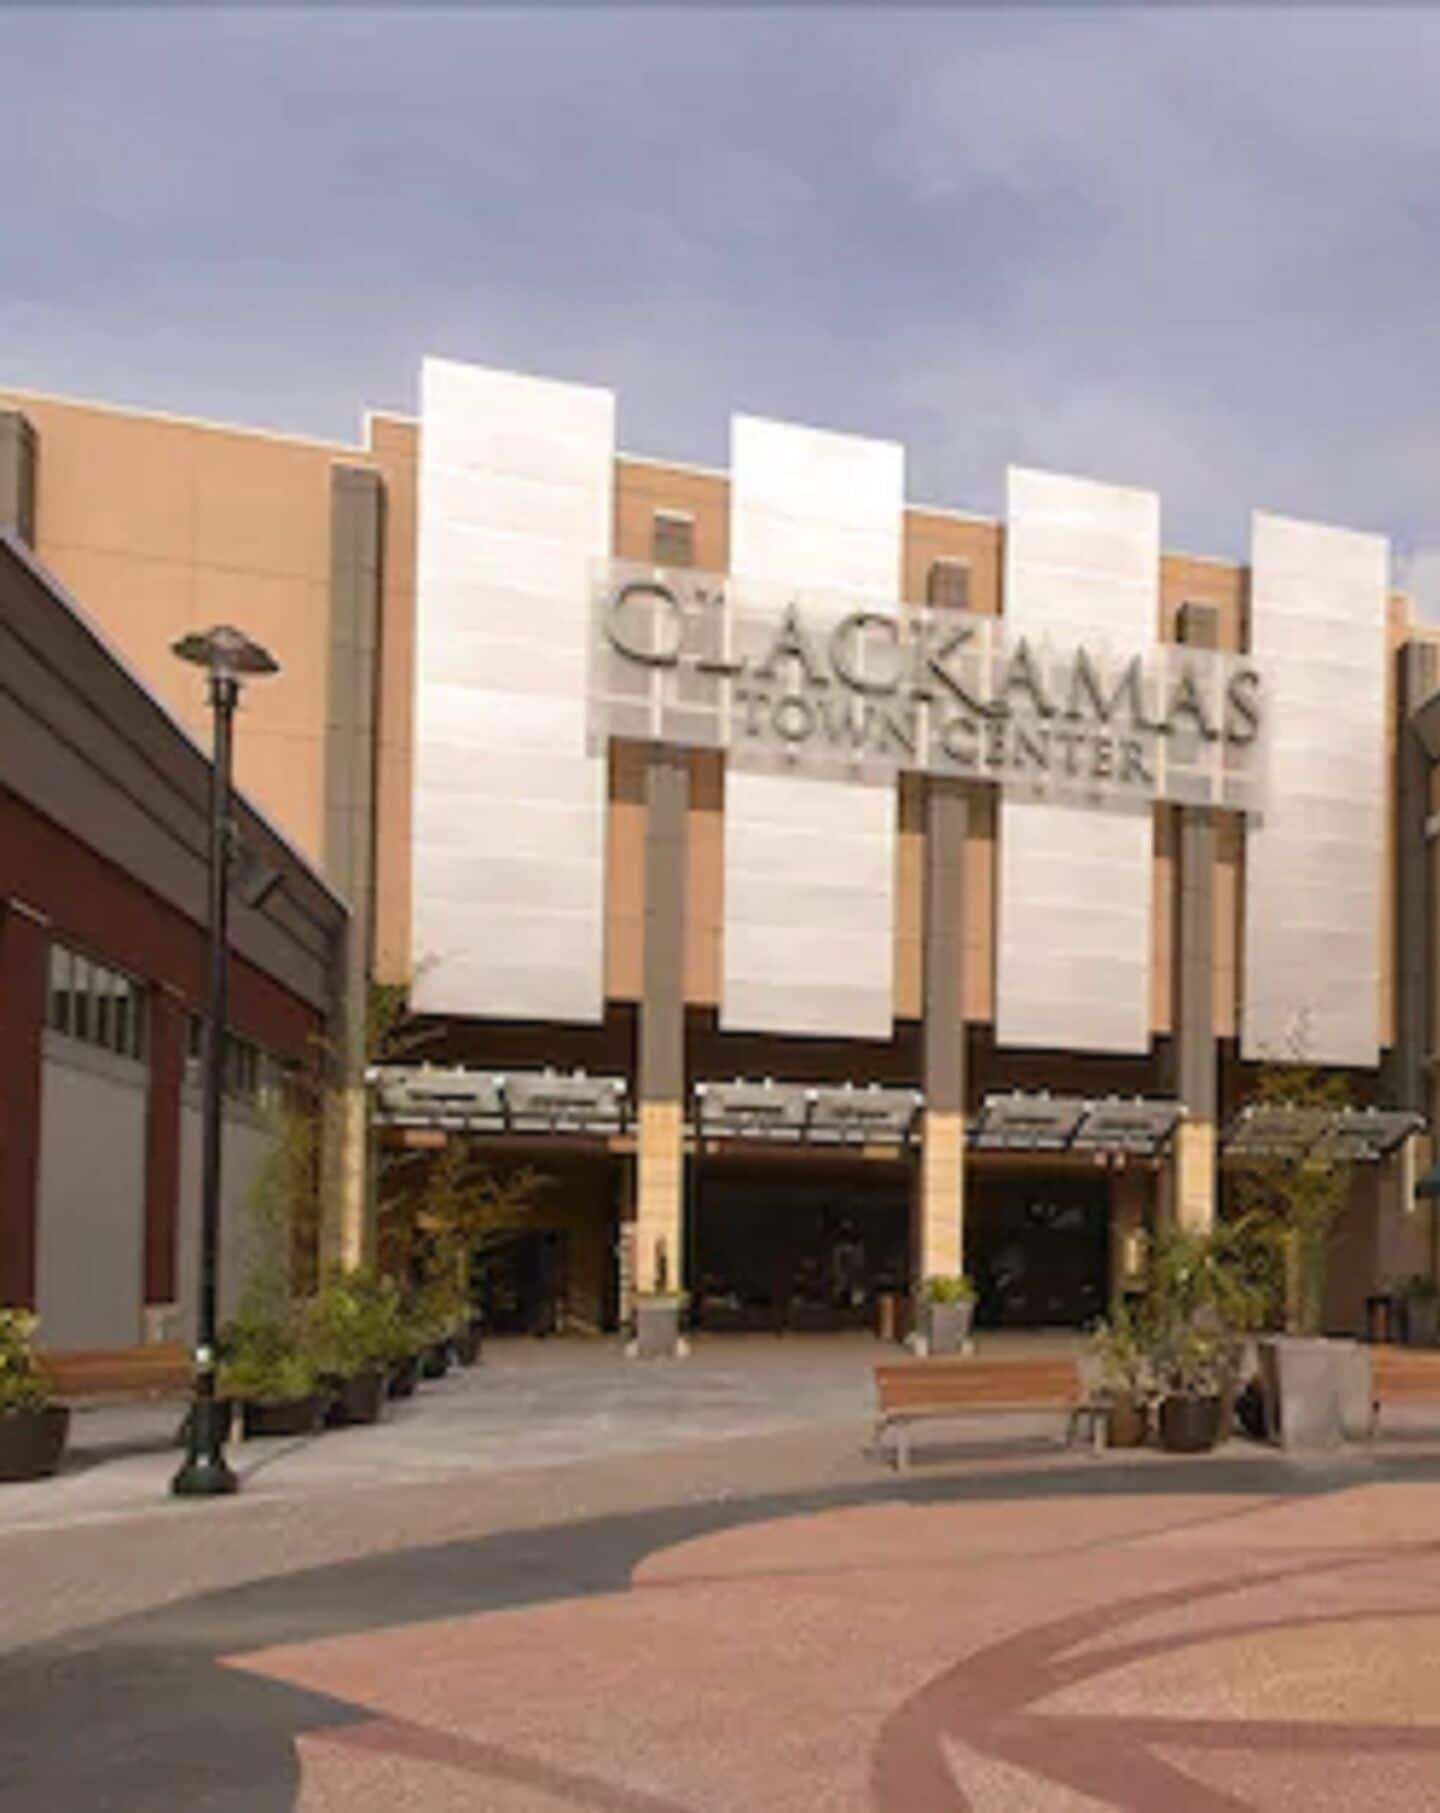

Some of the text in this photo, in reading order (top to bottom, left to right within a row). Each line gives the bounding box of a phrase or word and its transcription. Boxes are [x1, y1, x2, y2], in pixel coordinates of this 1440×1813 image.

[605, 581, 1263, 746] CLACKAMAS
[738, 688, 1156, 785] TOWN CENTER
